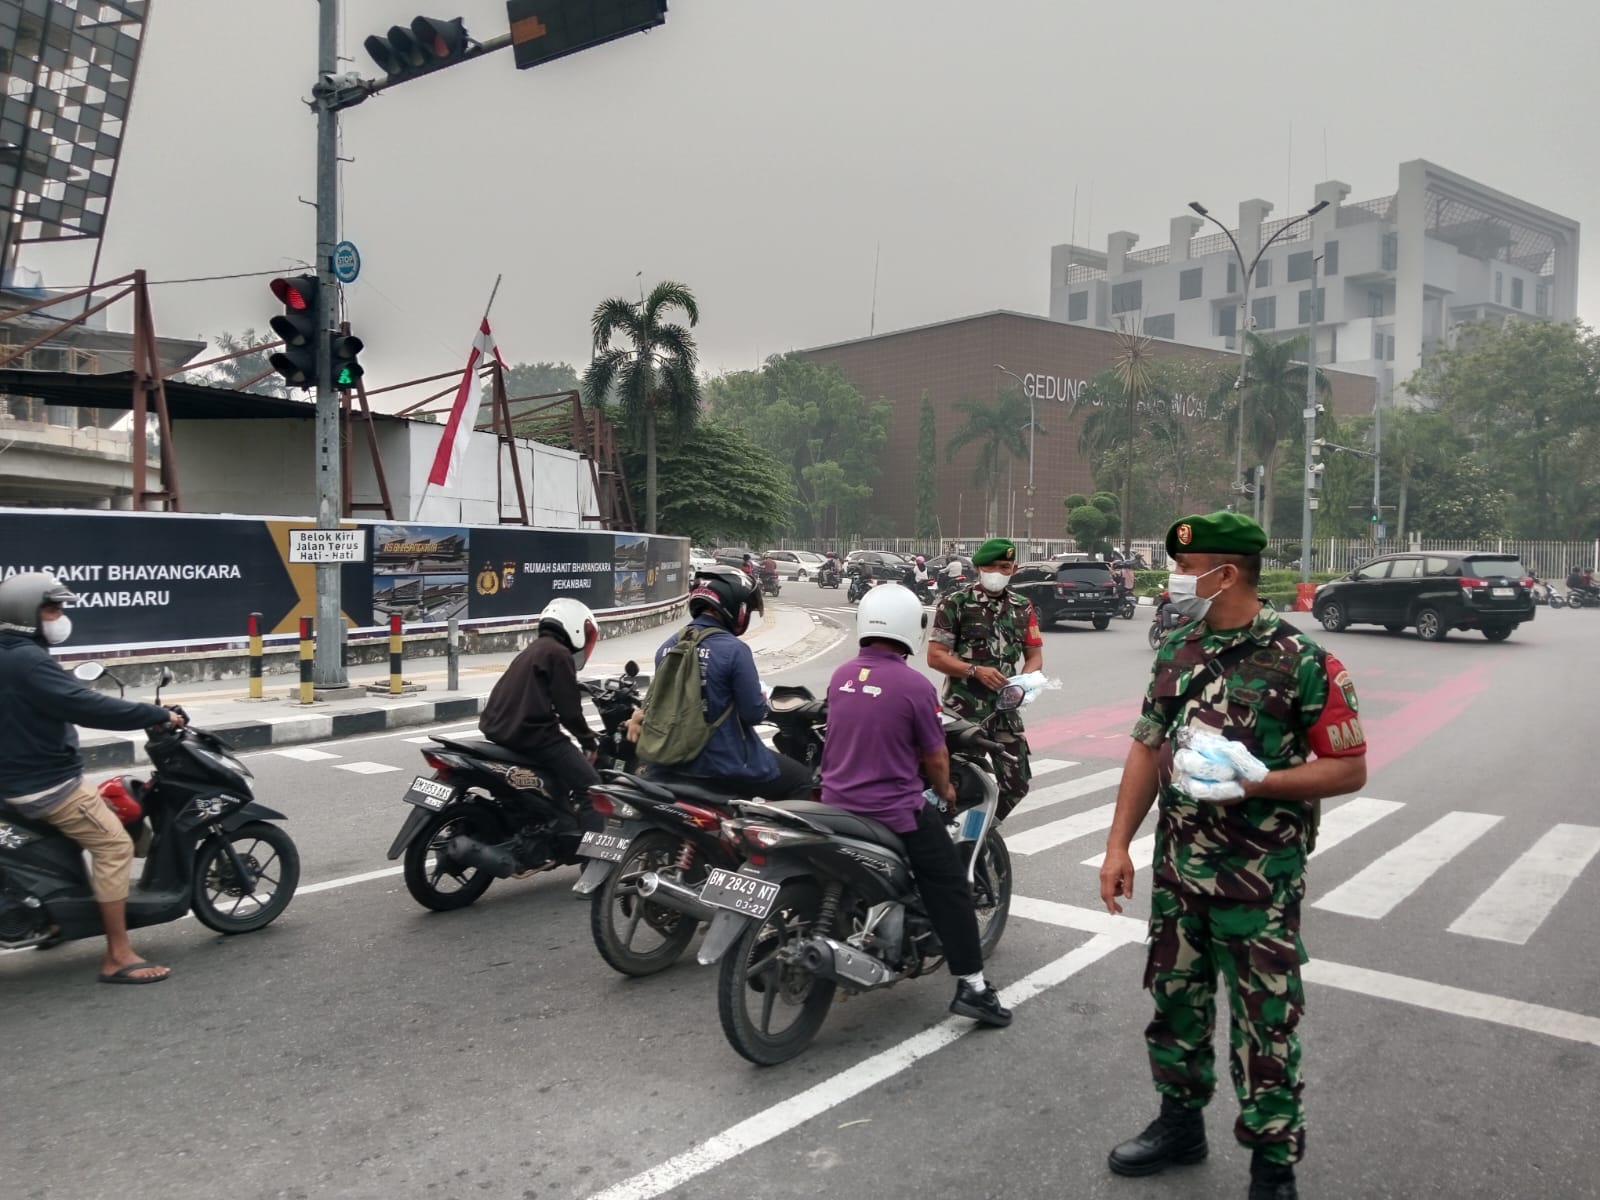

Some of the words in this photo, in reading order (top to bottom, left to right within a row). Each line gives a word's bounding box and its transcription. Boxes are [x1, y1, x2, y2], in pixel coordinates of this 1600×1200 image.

[300, 532, 332, 541] Belok
[335, 532, 354, 541] Kiri
[296, 542, 325, 551] Jalan
[328, 542, 359, 550] Terus
[300, 551, 322, 560] Hati
[332, 550, 354, 560] Hati
[41, 565, 102, 581] SAKIT
[107, 565, 241, 581] BHAYANGKARA
[524, 562, 551, 573] RUMAH
[552, 562, 571, 573] SAKIT
[552, 578, 592, 590] PEKANBARU
[581, 831, 594, 843] BM
[709, 871, 727, 887] BM
[724, 876, 757, 895] 2849
[757, 885, 776, 901] NT
